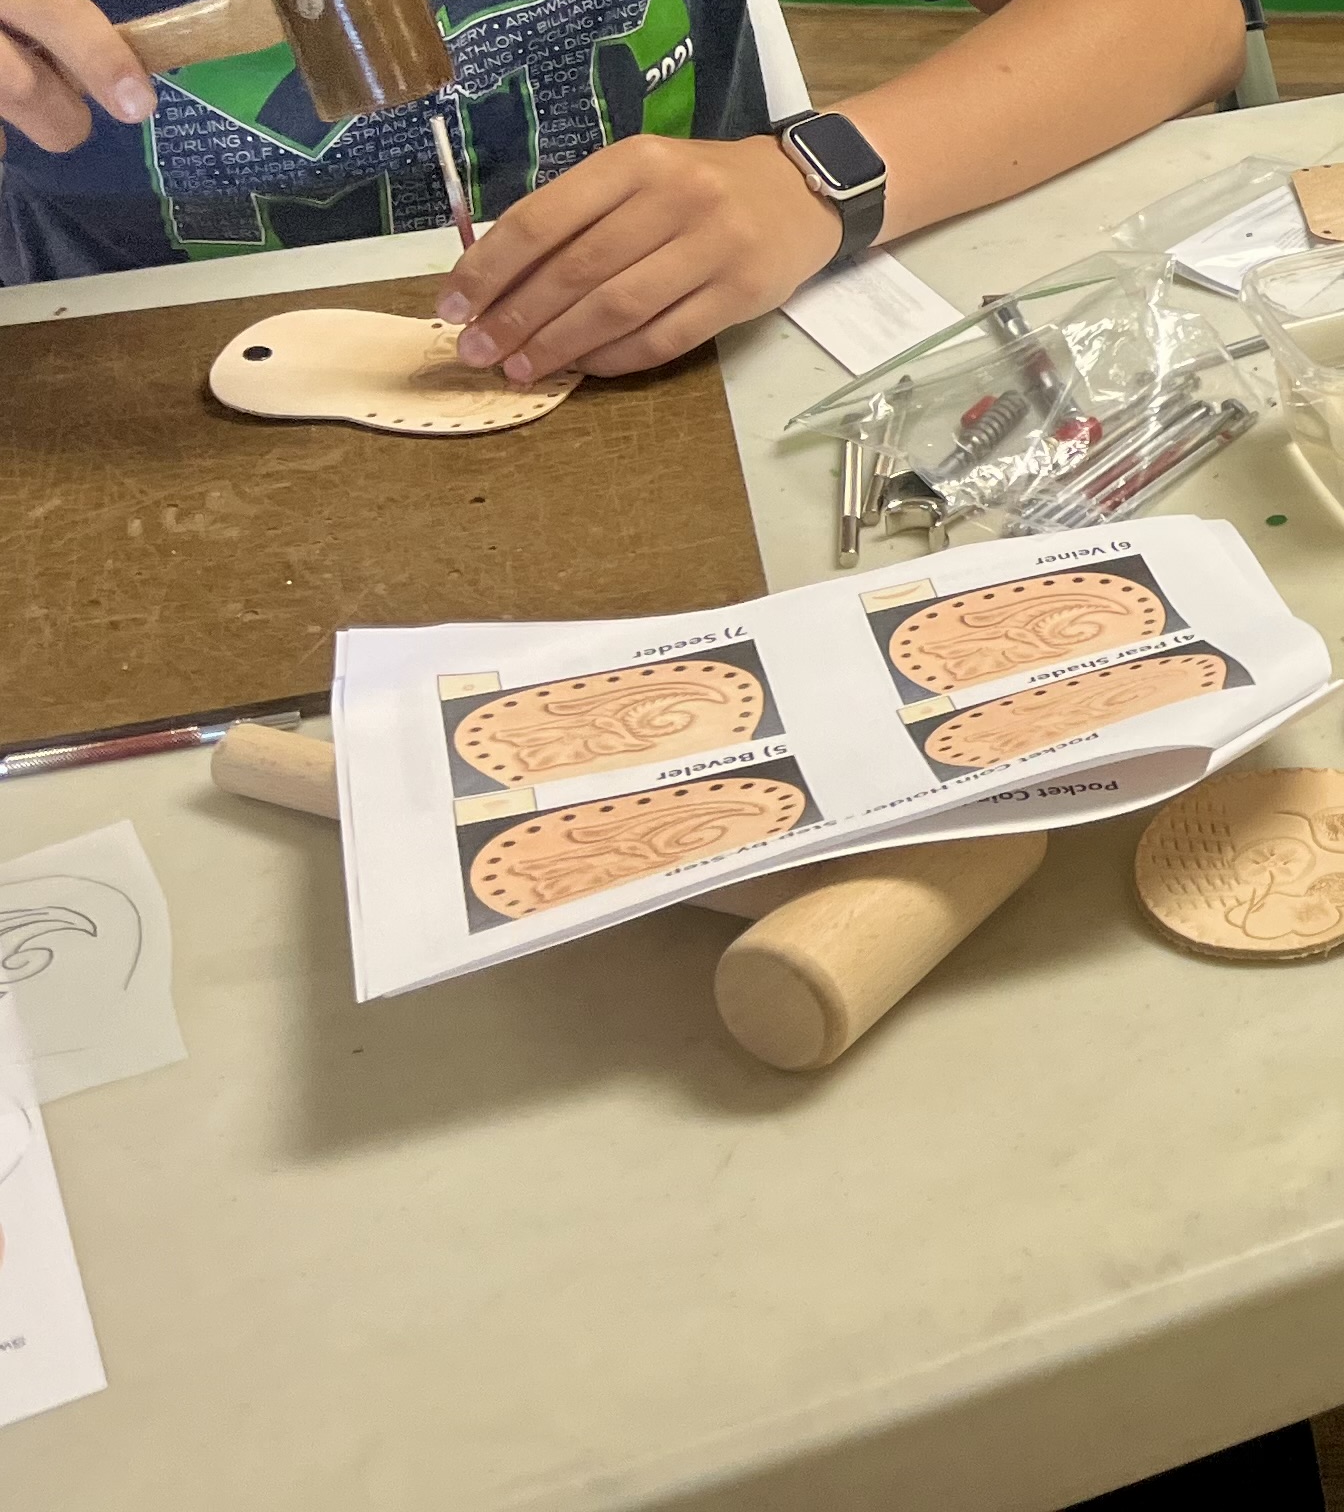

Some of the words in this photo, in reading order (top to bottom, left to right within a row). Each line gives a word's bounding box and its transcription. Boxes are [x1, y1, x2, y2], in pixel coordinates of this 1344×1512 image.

[449, 23, 488, 52] HERY
[454, 50, 514, 81] URLING
[158, 135, 241, 153] CURLING
[221, 147, 273, 164] GOLF
[1035, 543, 1107, 565] Veiner
[632, 632, 717, 659] Seeder
[1115, 642, 1167, 660] Pear
[1027, 657, 1110, 684] Shader
[763, 744, 787, 758] 5)
[1018, 732, 1100, 763] Pocket
[656, 752, 754, 780] Beveler
[954, 761, 1011, 785] Coin
[861, 784, 949, 815] Holder
[1038, 779, 1119, 800] Pocket
